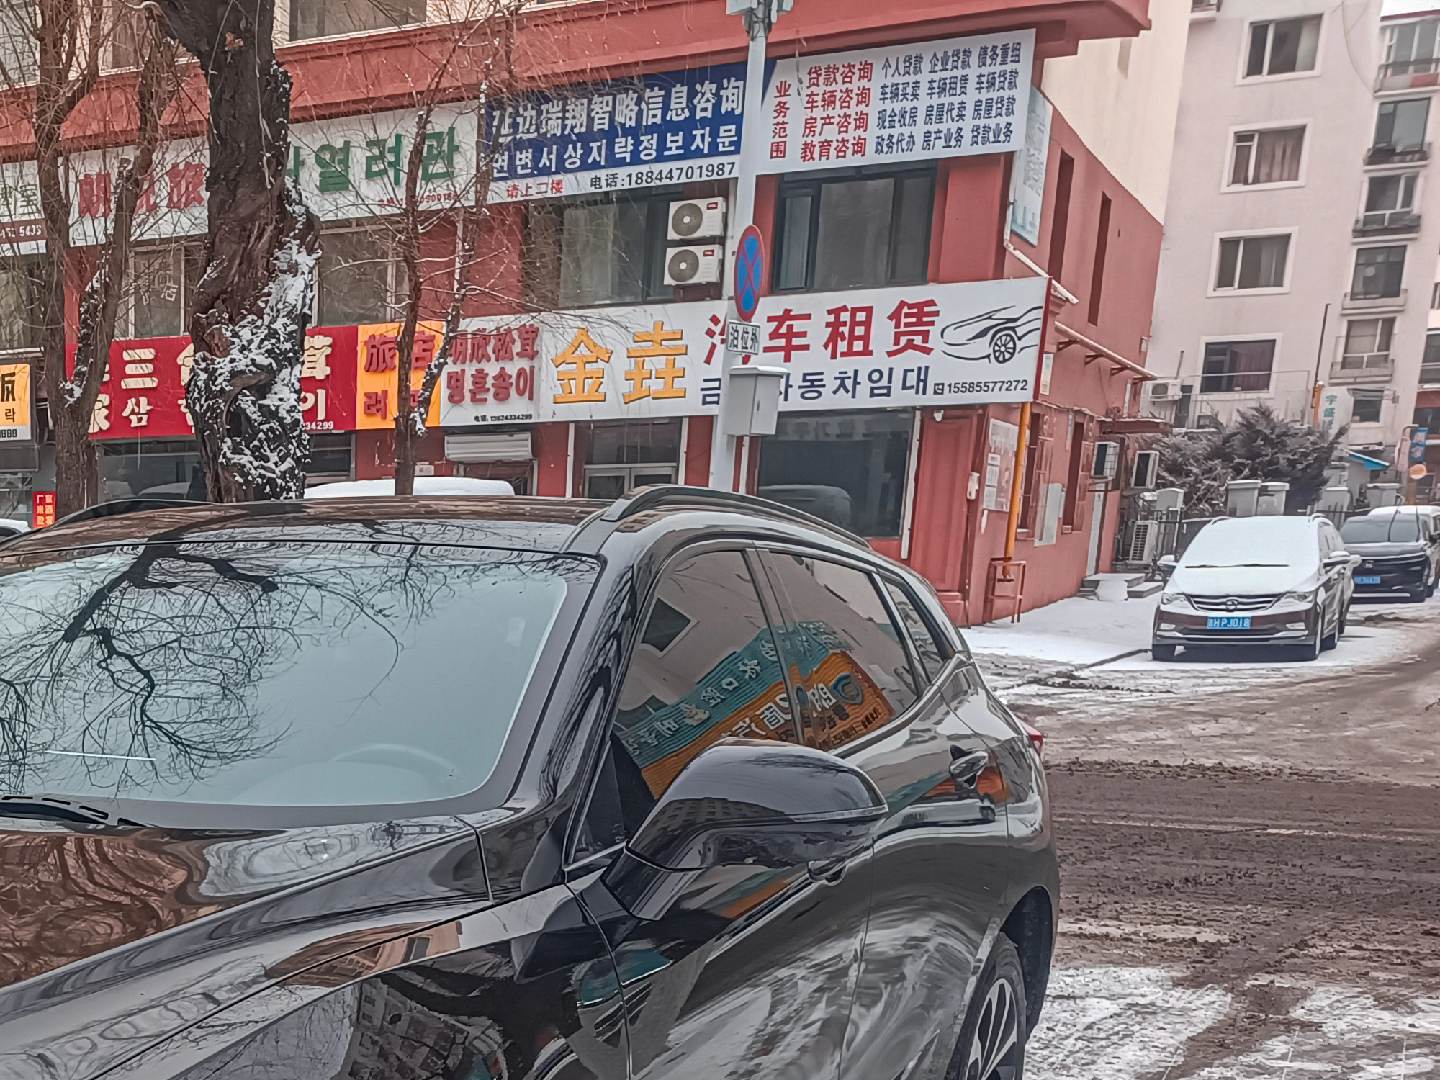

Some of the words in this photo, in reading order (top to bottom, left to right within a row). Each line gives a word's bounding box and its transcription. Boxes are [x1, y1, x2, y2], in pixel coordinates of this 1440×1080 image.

[806, 60, 874, 89] 贷款咨询
[881, 54, 924, 79] 个人贷款
[928, 48, 972, 75] 企业贷款
[804, 86, 871, 114] 车辆咨询
[879, 79, 921, 105] 车辆买卖
[926, 74, 969, 100] 车辆租赁
[975, 68, 1020, 95] 车辆贷款
[769, 80, 792, 160] 业务范围
[802, 110, 869, 138] 房产咨询
[876, 106, 919, 130] 现金收房
[923, 100, 967, 126] 房屋代卖
[972, 95, 1016, 121] 房屋贷款
[800, 136, 867, 163] 教育咨询
[874, 131, 916, 156] 政务代办
[921, 127, 964, 151] 房产业务
[970, 121, 1014, 147] 贷款业务
[700, 365, 931, 406] 금동차임대
[947, 379, 1028, 395] 15585577272
